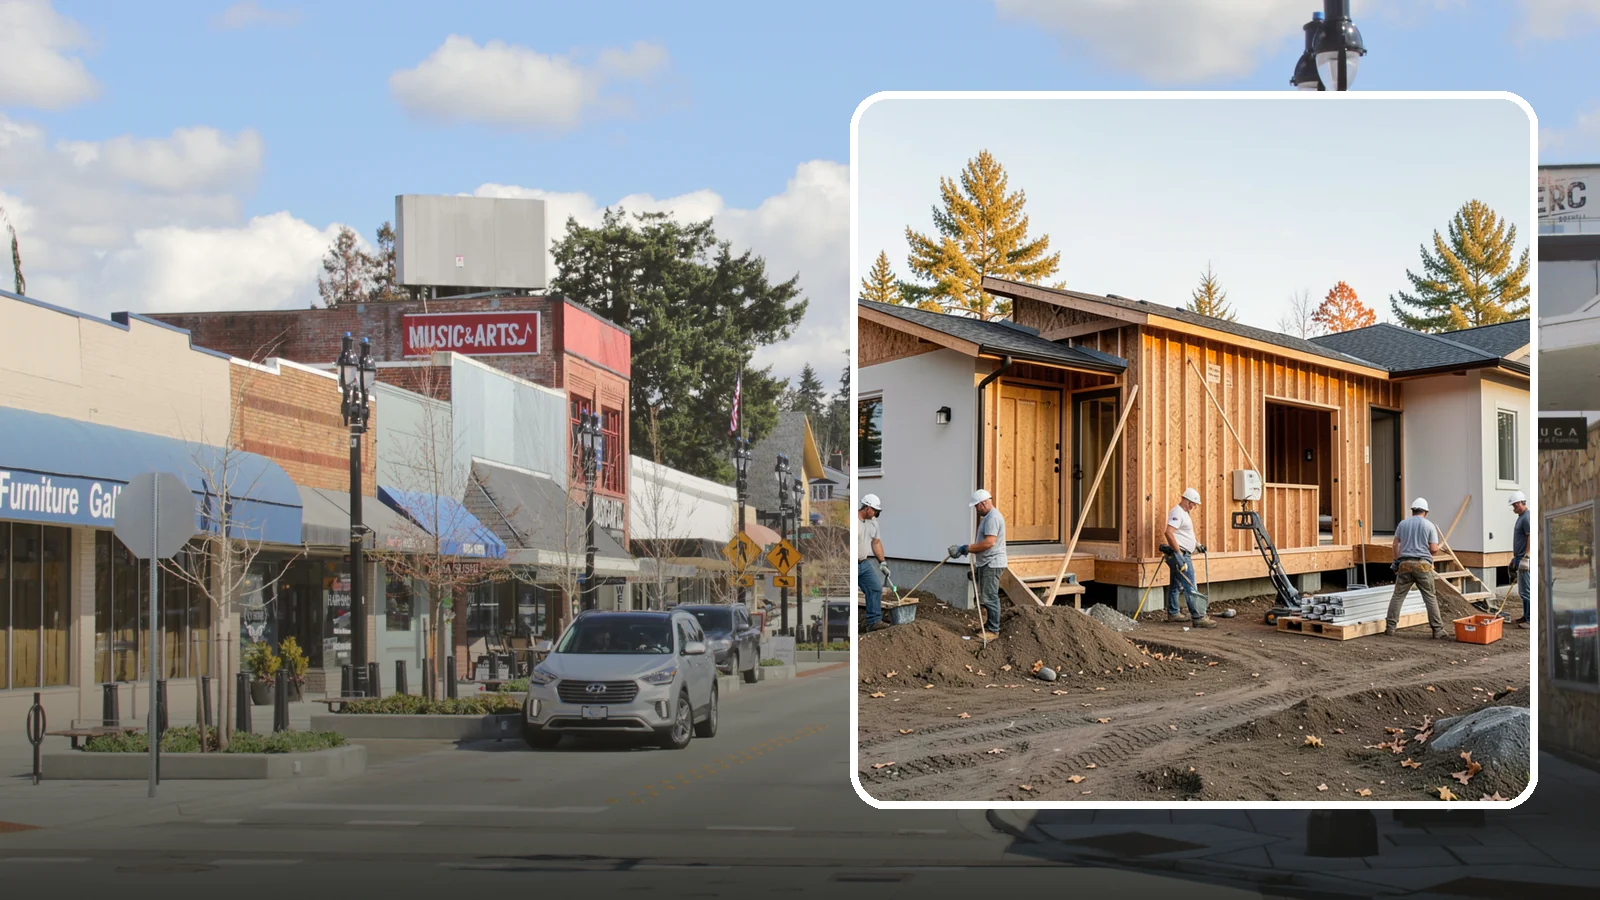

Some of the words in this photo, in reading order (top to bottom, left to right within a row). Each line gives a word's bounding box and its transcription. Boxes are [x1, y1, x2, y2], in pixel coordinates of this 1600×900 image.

[409, 323, 519, 349] MUSIC&ARTS
[0, 472, 79, 515] Furniture
[89, 482, 121, 519] Gal
